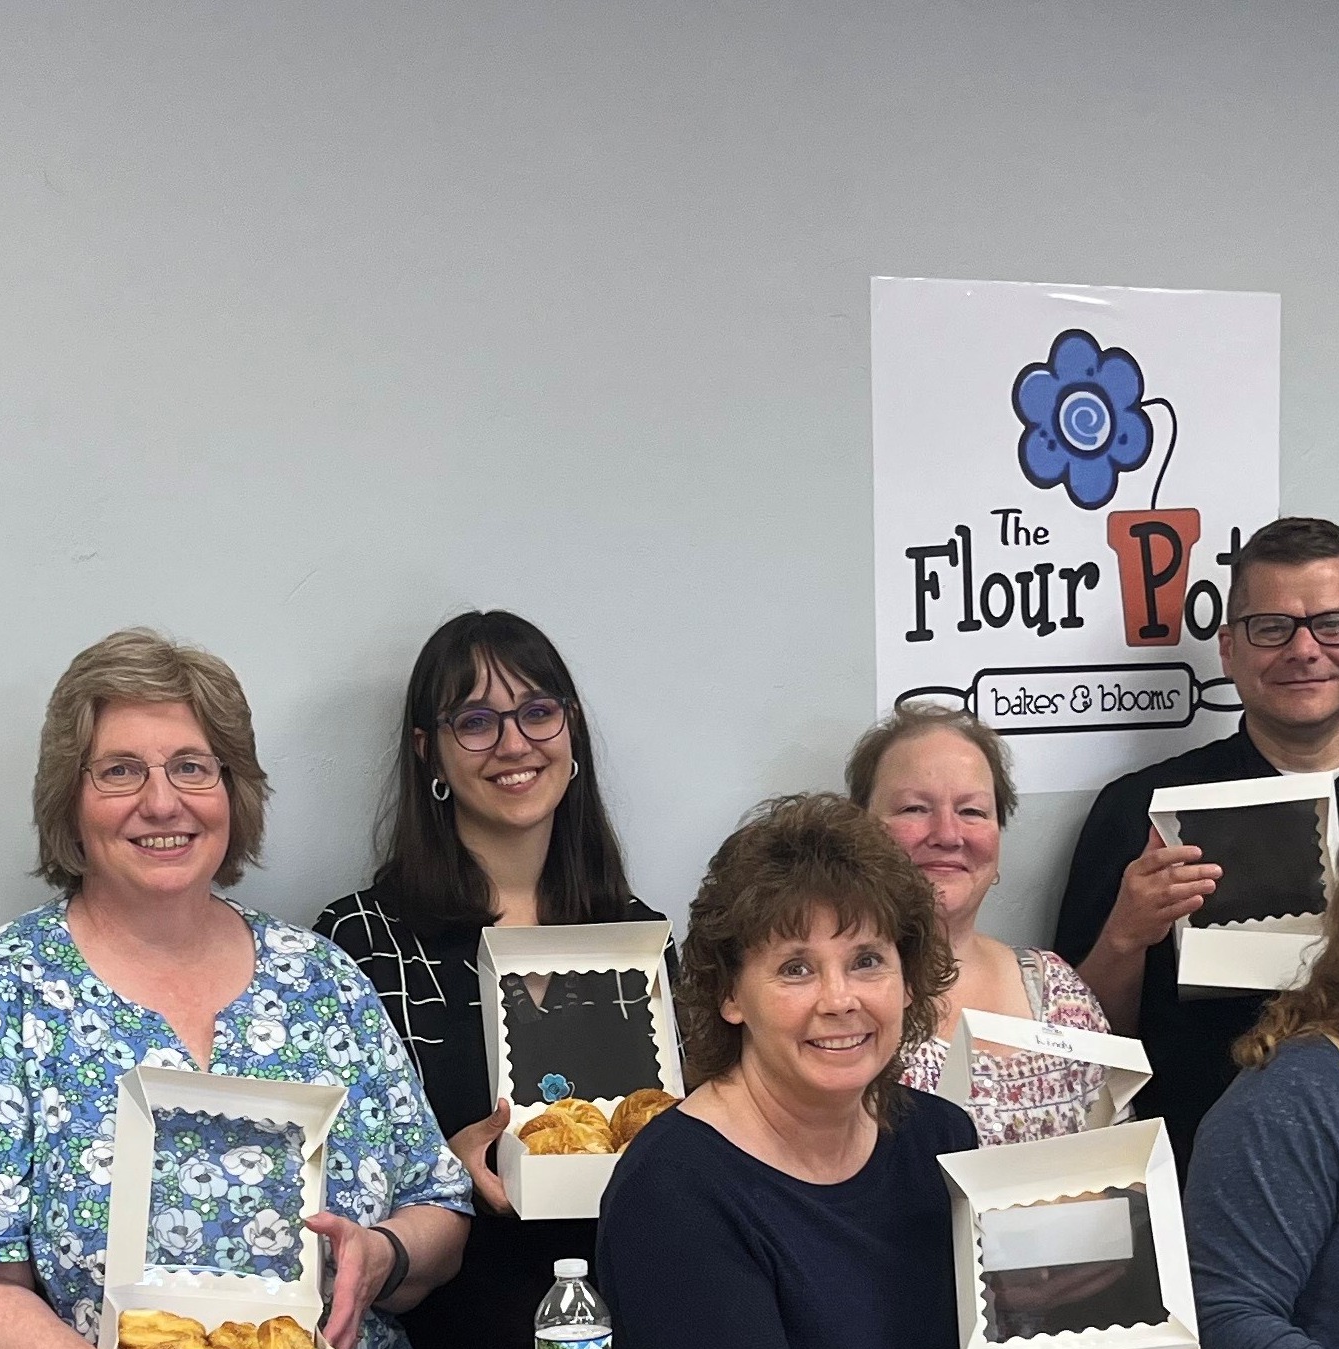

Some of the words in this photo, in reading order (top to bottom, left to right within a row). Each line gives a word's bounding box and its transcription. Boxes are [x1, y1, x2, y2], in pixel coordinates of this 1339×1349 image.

[991, 509, 1050, 546] The
[905, 525, 1100, 643] Flour
[990, 687, 1065, 716] bakes
[1070, 685, 1093, 714] &
[1097, 683, 1181, 712] blooms
